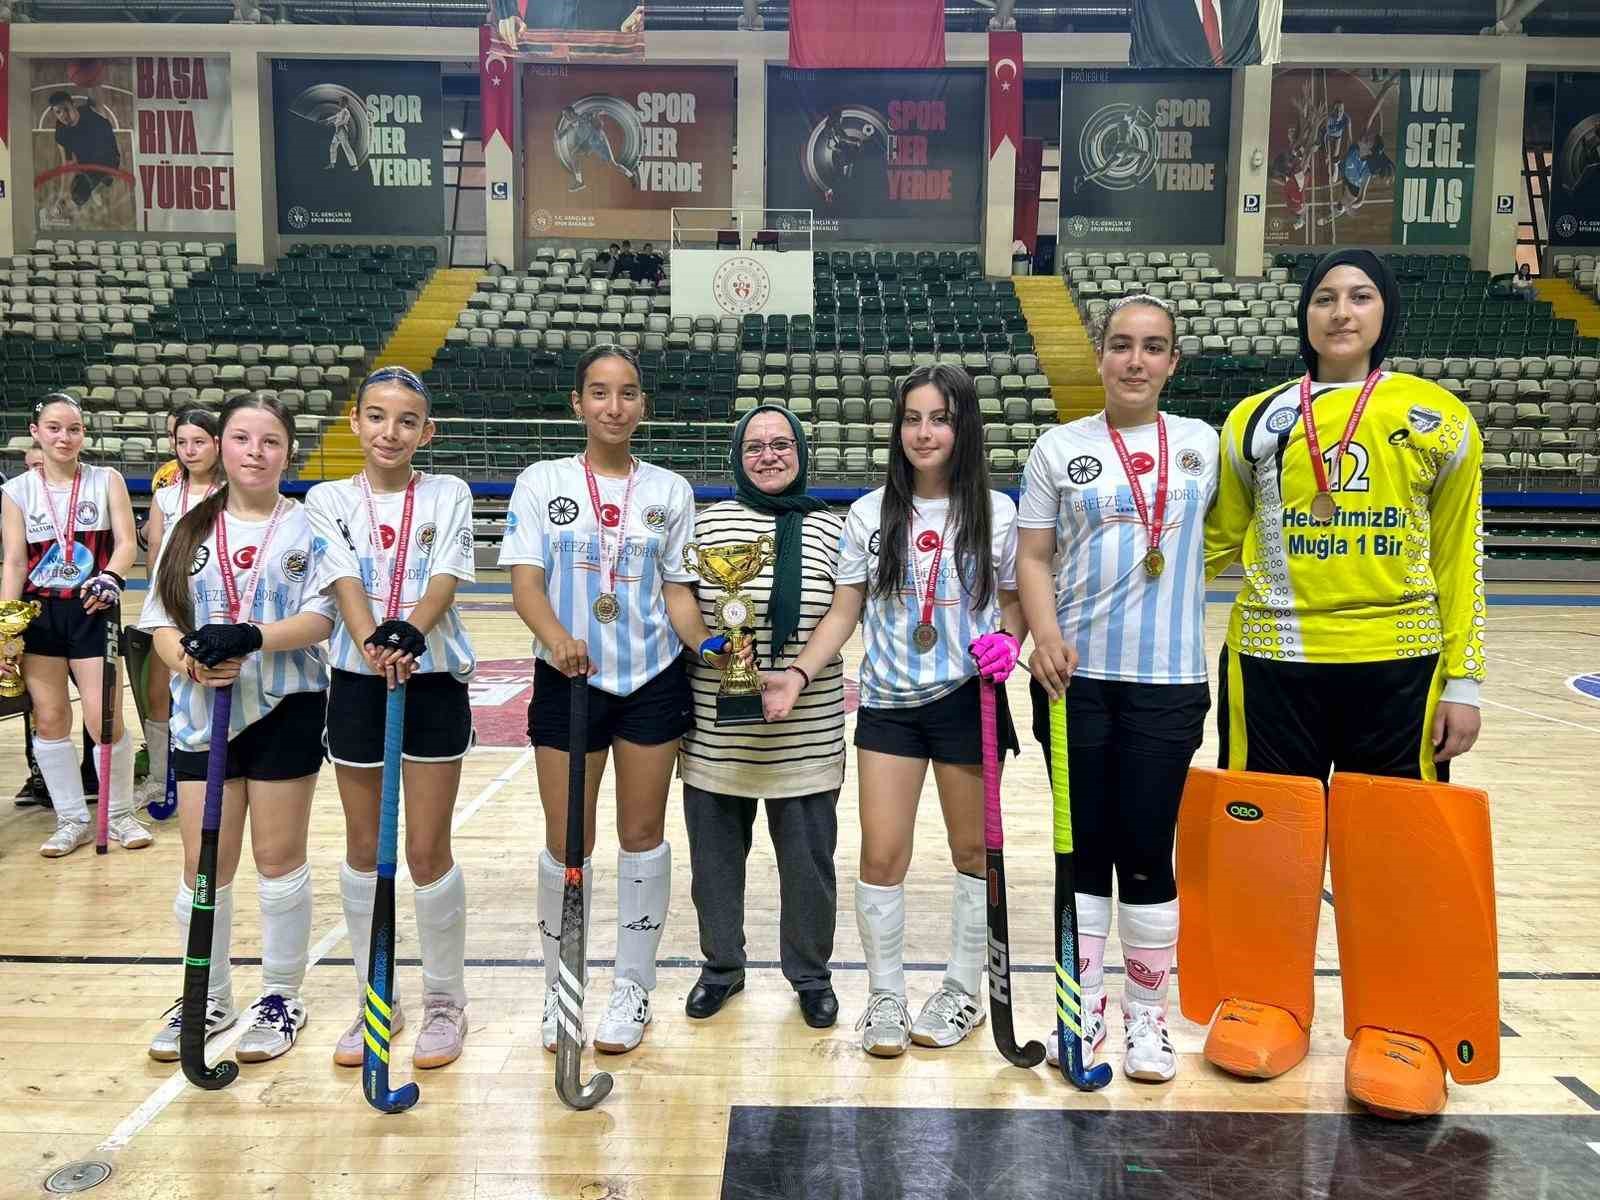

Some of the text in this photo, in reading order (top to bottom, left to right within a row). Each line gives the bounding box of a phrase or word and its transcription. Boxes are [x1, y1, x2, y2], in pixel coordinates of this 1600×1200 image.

[368, 94, 423, 124] SPOR
[637, 92, 696, 124] SPOR
[888, 100, 947, 131] SPOR
[1155, 98, 1211, 127] SPOR
[368, 126, 407, 154] HER
[641, 127, 678, 157] HER
[1158, 131, 1192, 160] HER
[369, 158, 433, 187] YERDE
[638, 161, 703, 192] YERDE
[888, 170, 952, 200] YERDE
[1155, 163, 1215, 191] YERDE
[494, 183, 505, 195] C
[1247, 195, 1258, 206] D
[1402, 178, 1462, 227] ULAŞ
[1500, 197, 1511, 207] D
[1322, 440, 1370, 492] 12
[1288, 533, 1403, 560] Muğla 1 Bir
[1230, 806, 1259, 826] OBO
